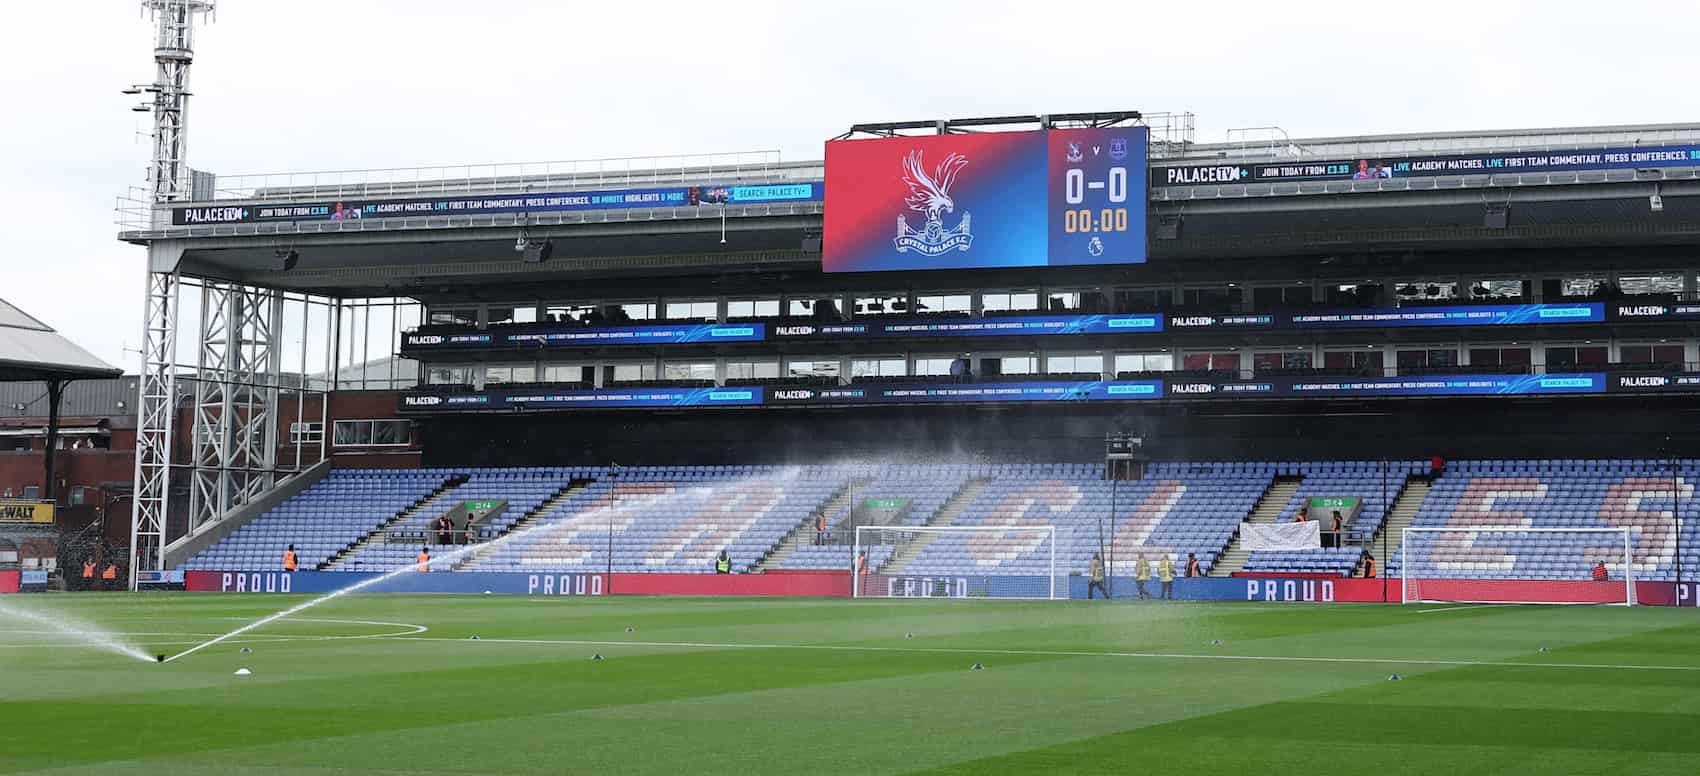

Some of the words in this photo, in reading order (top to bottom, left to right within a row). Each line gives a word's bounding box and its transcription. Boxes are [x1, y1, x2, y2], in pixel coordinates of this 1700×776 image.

[1261, 167, 1279, 177] JOIN
[1279, 167, 1303, 176] TODAY
[1305, 165, 1326, 175] FROM
[1393, 162, 1410, 171] LIVE
[1412, 161, 1446, 170] ACADEMY
[1486, 158, 1503, 168] LIVE
[1504, 158, 1526, 167] FIRST
[1527, 157, 1548, 167] TEAM
[1605, 153, 1630, 163] PRESS
[259, 208, 274, 217] JOIN
[274, 208, 294, 217] TODAY
[294, 207, 310, 216] FROM
[362, 204, 377, 213] LIVE
[377, 203, 404, 212] ACADEMY
[434, 201, 449, 210] LIVE
[449, 200, 466, 210] FIRST
[467, 200, 483, 209] TEAM
[525, 197, 545, 207] PRESS
[625, 193, 660, 203] HIGHLIGHTS
[666, 191, 684, 201] MORE
[1065, 208, 1127, 233] 00:00
[899, 238, 929, 253] CRYSTAL
[929, 239, 956, 253] PALACE
[222, 573, 291, 593] PROUD
[528, 575, 602, 595] PROUD
[1247, 580, 1334, 601] PROUD
[1675, 583, 1700, 607] P
